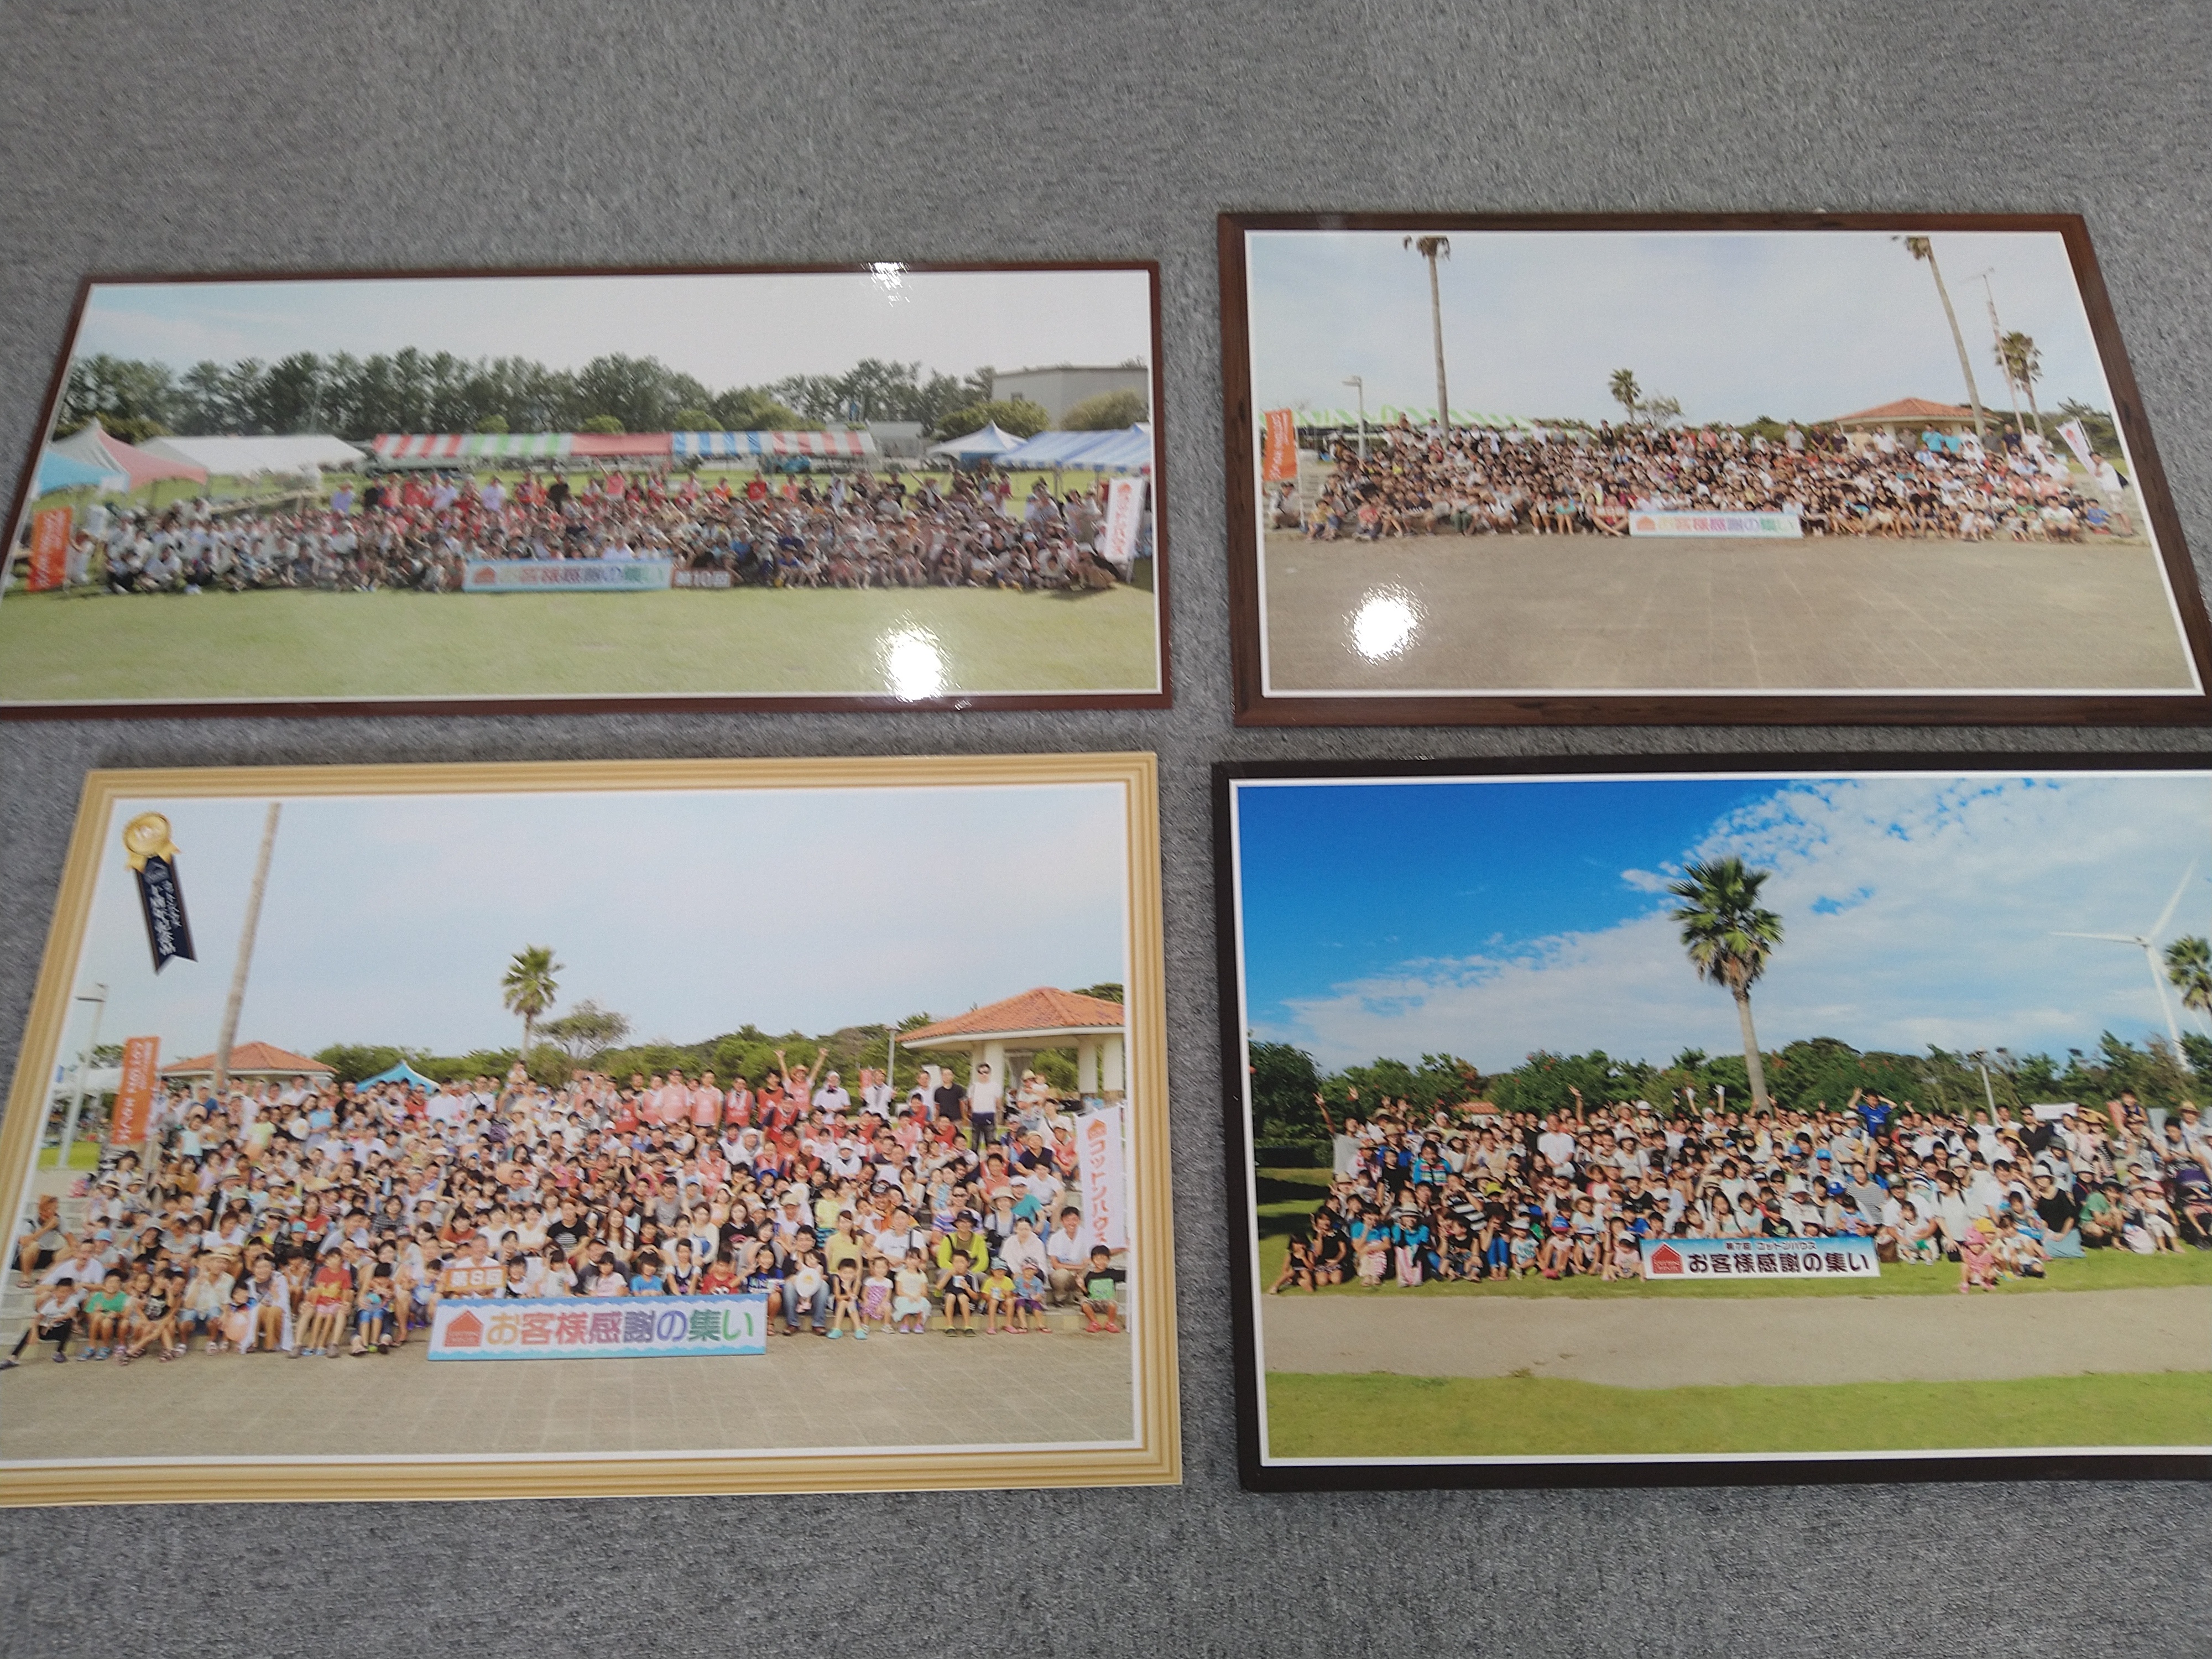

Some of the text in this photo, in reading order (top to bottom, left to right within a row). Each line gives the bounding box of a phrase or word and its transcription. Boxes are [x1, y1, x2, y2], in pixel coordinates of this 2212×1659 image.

[1688, 1252, 1871, 1274] お客様感謝の集い
[487, 1309, 755, 1345] お客様感謝の集い
